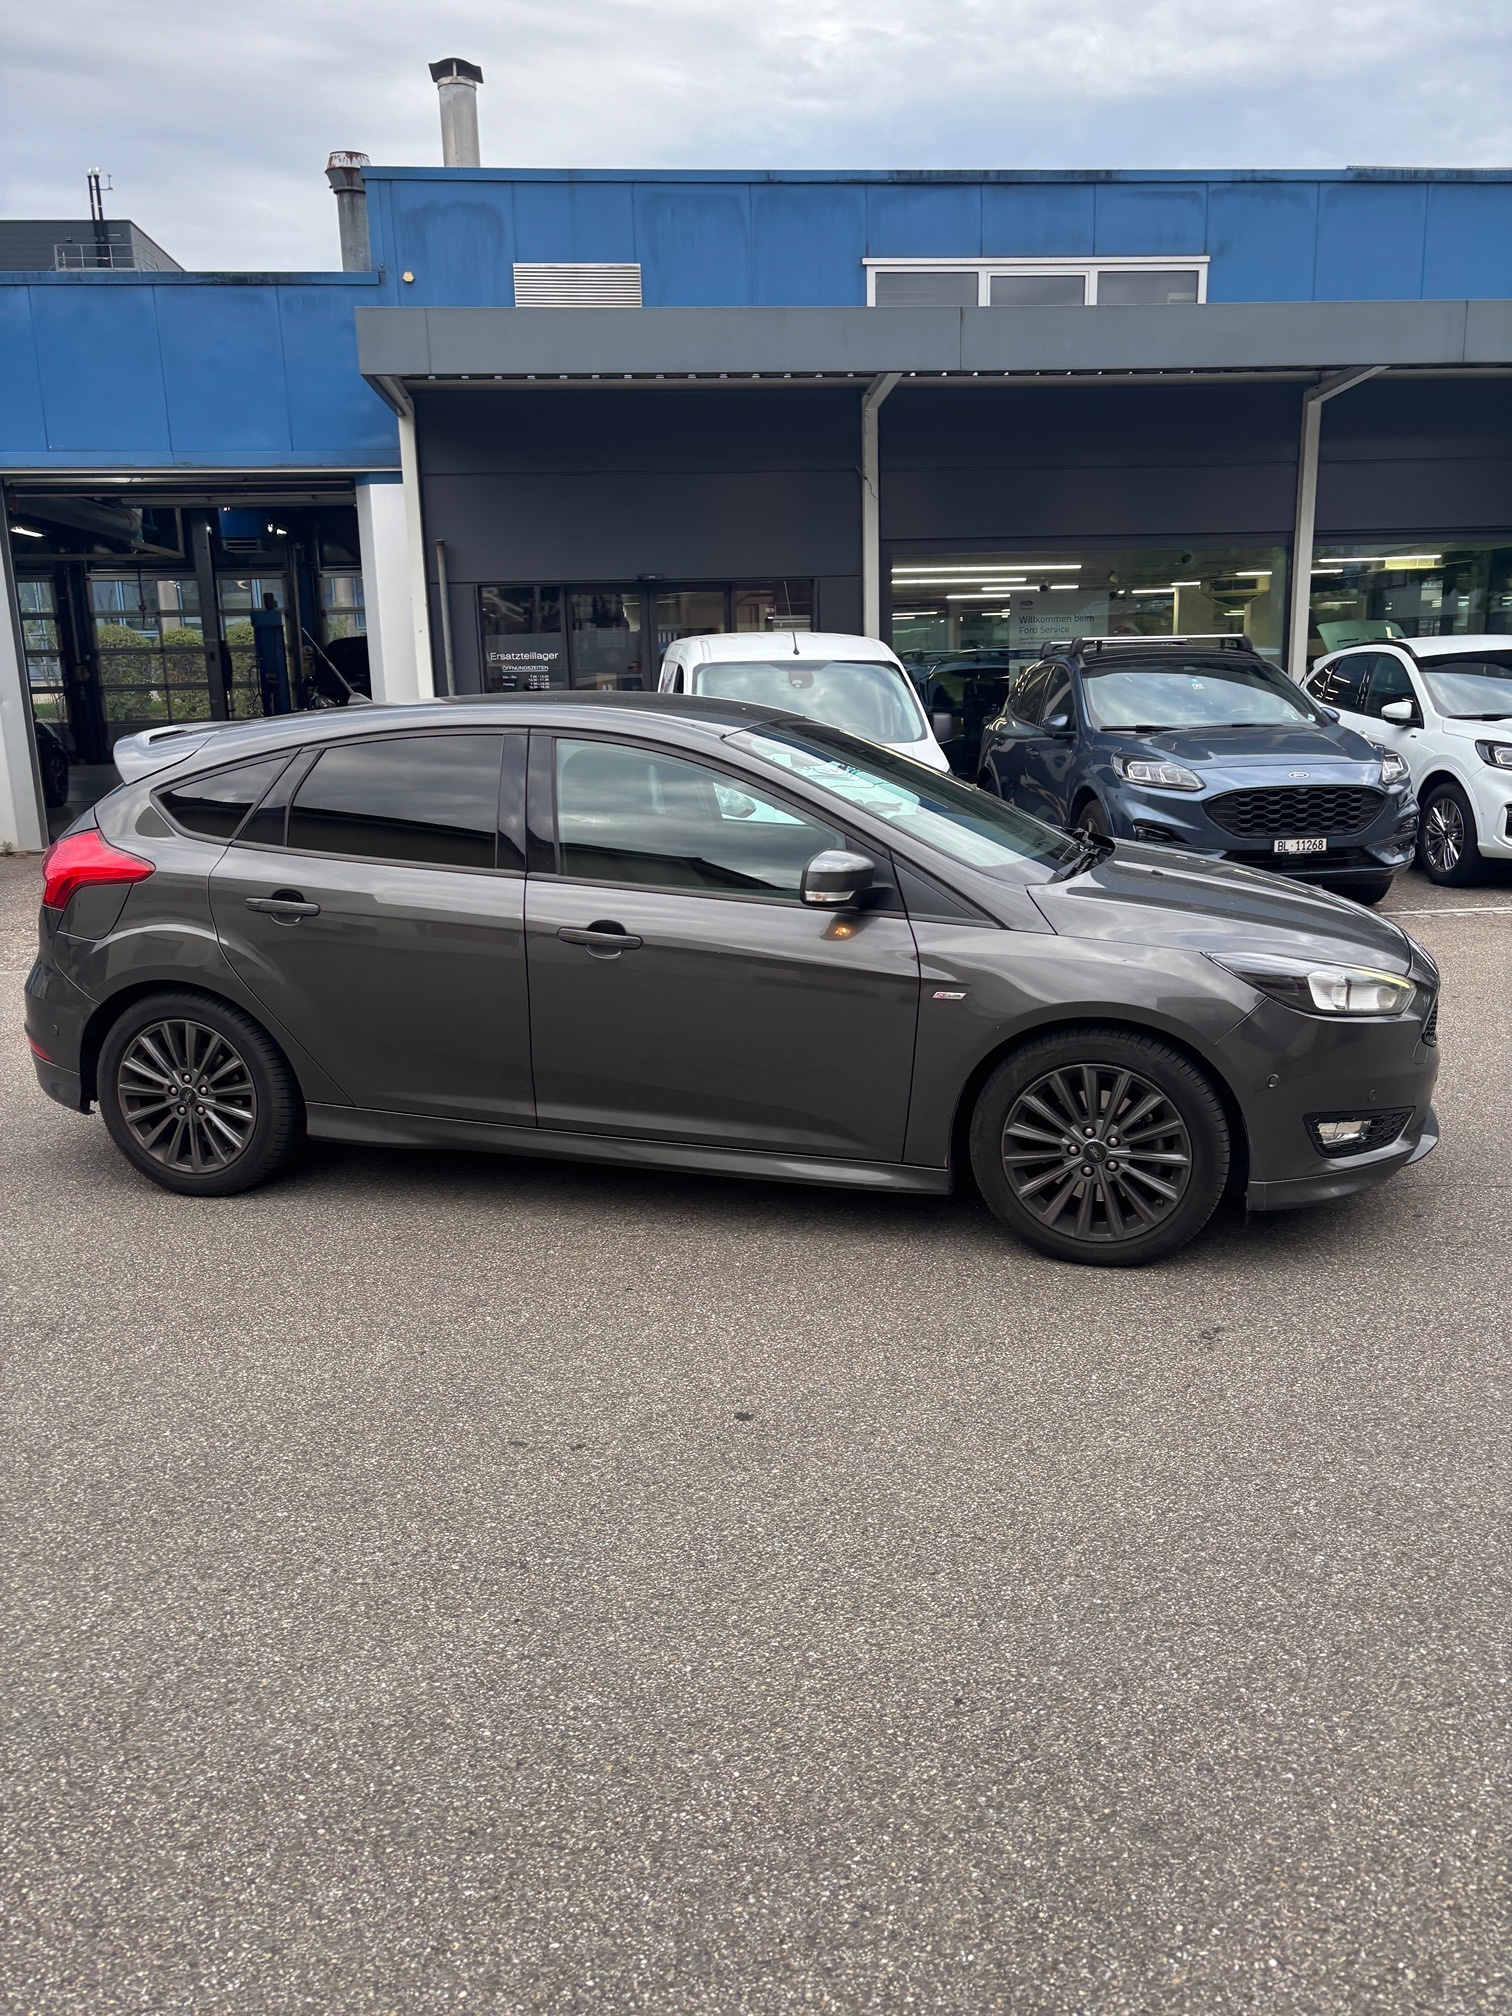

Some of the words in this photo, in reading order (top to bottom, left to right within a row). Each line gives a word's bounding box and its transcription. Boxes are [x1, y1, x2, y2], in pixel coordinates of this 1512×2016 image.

[1019, 616, 1072, 624] Willkommen
[1019, 626, 1038, 634] Ford
[1040, 626, 1070, 634] Service
[490, 652, 559, 661] Ersatzteillager
[1277, 841, 1289, 852] BL
[1295, 840, 1324, 851] 11268
